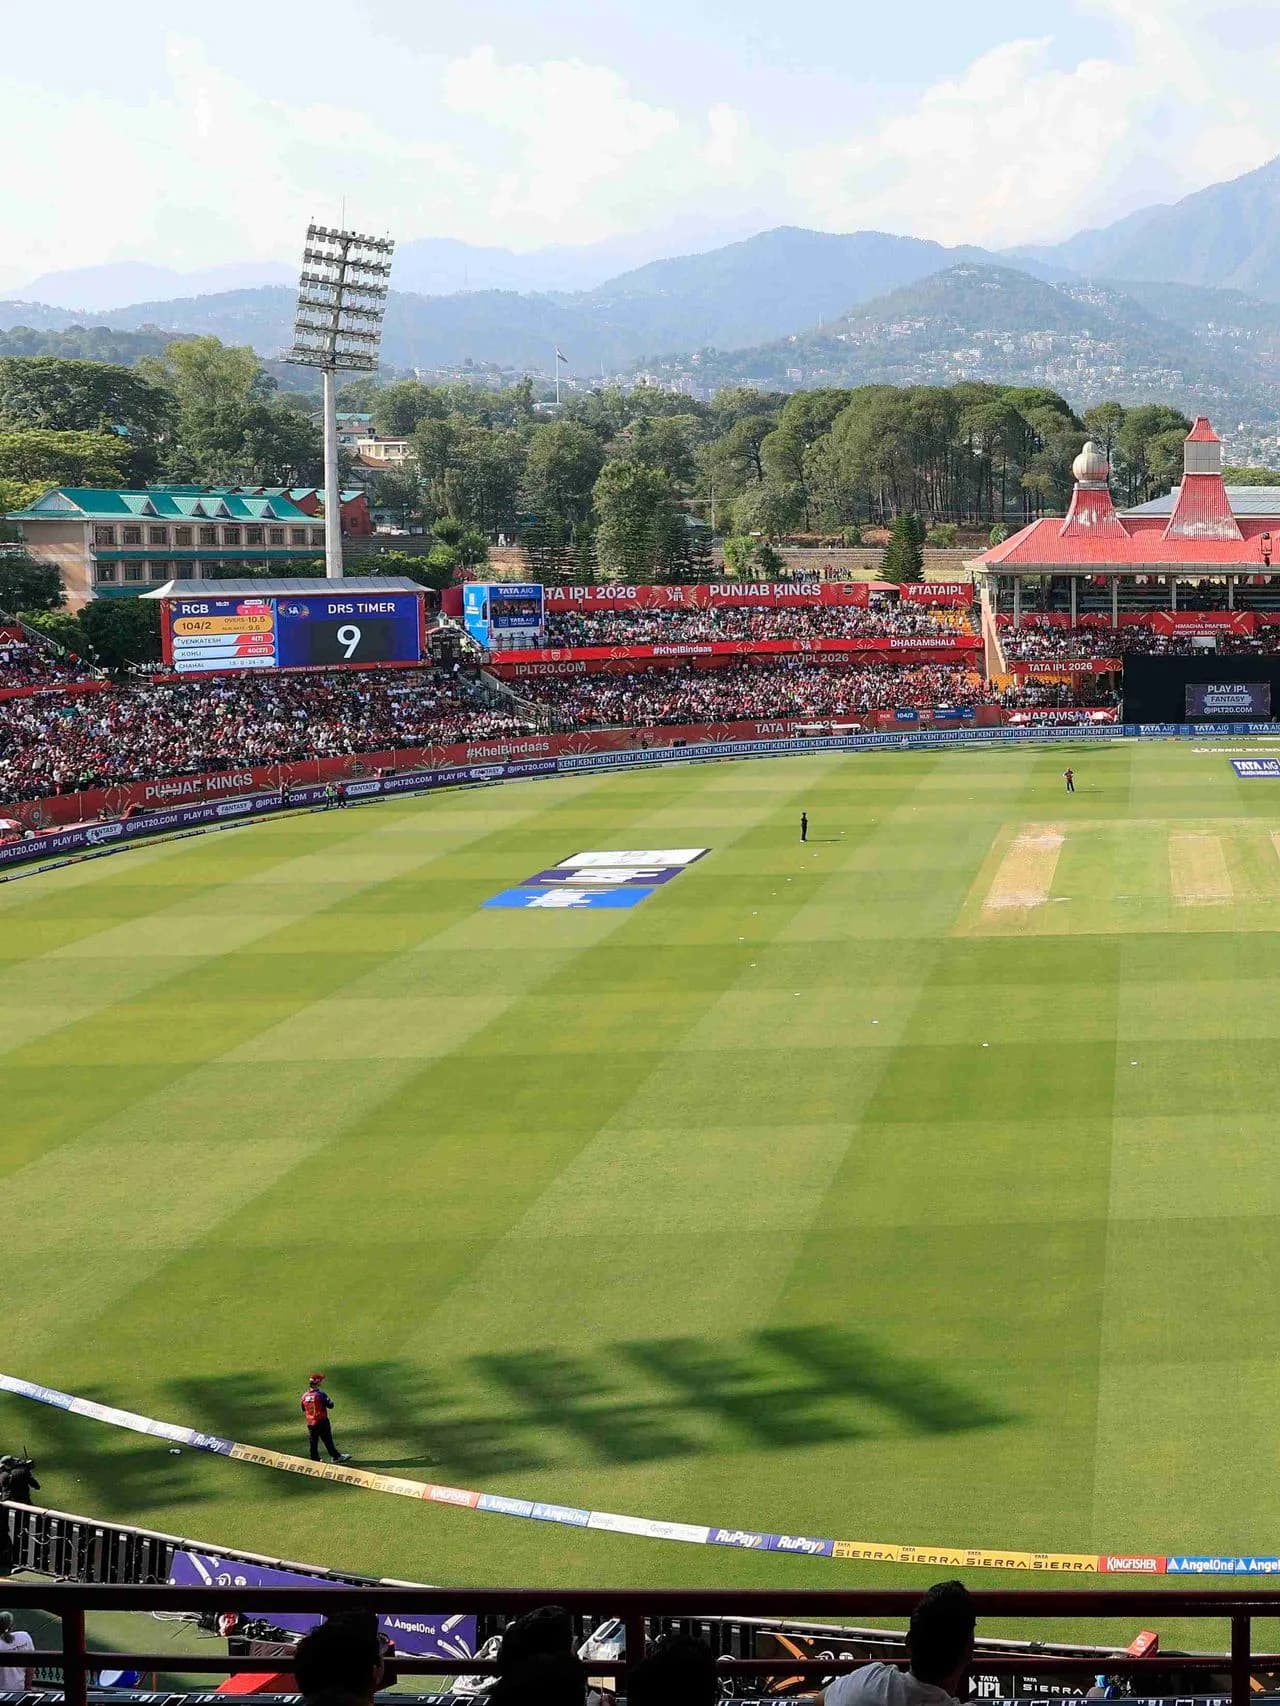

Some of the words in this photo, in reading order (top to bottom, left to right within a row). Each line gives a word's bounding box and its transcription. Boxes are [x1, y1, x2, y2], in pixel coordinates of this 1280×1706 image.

[498, 587, 520, 595] TATA
[569, 587, 592, 599] IPL
[596, 586, 637, 599] 2026
[709, 584, 770, 597] PUNJAB
[774, 584, 821, 597] KINGS
[908, 585, 965, 595] #TATAIPL
[182, 604, 209, 614] RCB
[327, 603, 355, 614] DRS
[357, 602, 396, 613] TIMER
[182, 621, 212, 630] 104/2
[247, 615, 266, 623] 10.5
[336, 624, 361, 659] 9
[890, 638, 955, 647] DHARAMSHALA
[653, 645, 712, 655] #KhelBindaas
[773, 654, 800, 663] TATA
[801, 653, 819, 663] IPL
[821, 653, 849, 663] 2026
[515, 662, 587, 676] IPLT20.COM
[1028, 663, 1051, 672] TATA
[1053, 662, 1068, 671] IPL
[1069, 662, 1093, 671] 2026
[1207, 685, 1232, 693] PLAY
[1203, 706, 1253, 714] @IPLT20.COM
[755, 723, 784, 734] TATA
[466, 741, 550, 759] #KhelBindaas
[507, 761, 556, 775] @IPLT20.COM
[1233, 761, 1263, 770] TATA
[1263, 761, 1280, 770] AIG
[206, 773, 253, 791] KINGS
[383, 776, 433, 789] @IPLT20.COM
[438, 773, 455, 781] PLAY
[350, 783, 377, 793] FANTASY
[221, 803, 247, 812] FANTASY
[255, 793, 308, 809] @IPLT2COM
[183, 810, 201, 822] PLAY
[202, 809, 215, 818] IPL
[126, 815, 179, 832] @IPLT20.COM
[52, 834, 72, 848] PLAY
[72, 833, 85, 844] IPL
[0, 841, 47, 860] IPLT20.COM
[193, 1433, 225, 1453] RuPay
[231, 1449, 274, 1466] SIERRA
[276, 1460, 321, 1477] SIERRA
[324, 1471, 370, 1487] SIERRA
[374, 1482, 422, 1497] SIERRA
[487, 1496, 533, 1513] AngelOne
[544, 1506, 589, 1523] AngelOne
[715, 1529, 756, 1547] RuPay
[777, 1535, 819, 1553] RuPay
[835, 1549, 895, 1560] SIERRA
[900, 1554, 961, 1565] SIERRA
[966, 1558, 1028, 1567] SIERRA
[1033, 1561, 1095, 1571] SIERRA
[1107, 1556, 1158, 1571] KINGFISHER
[1180, 1558, 1234, 1573] AngelOne
[393, 1619, 436, 1637] AngelOne
[978, 1682, 1005, 1698] IPL
[1023, 1683, 1084, 1695] SIERRA
